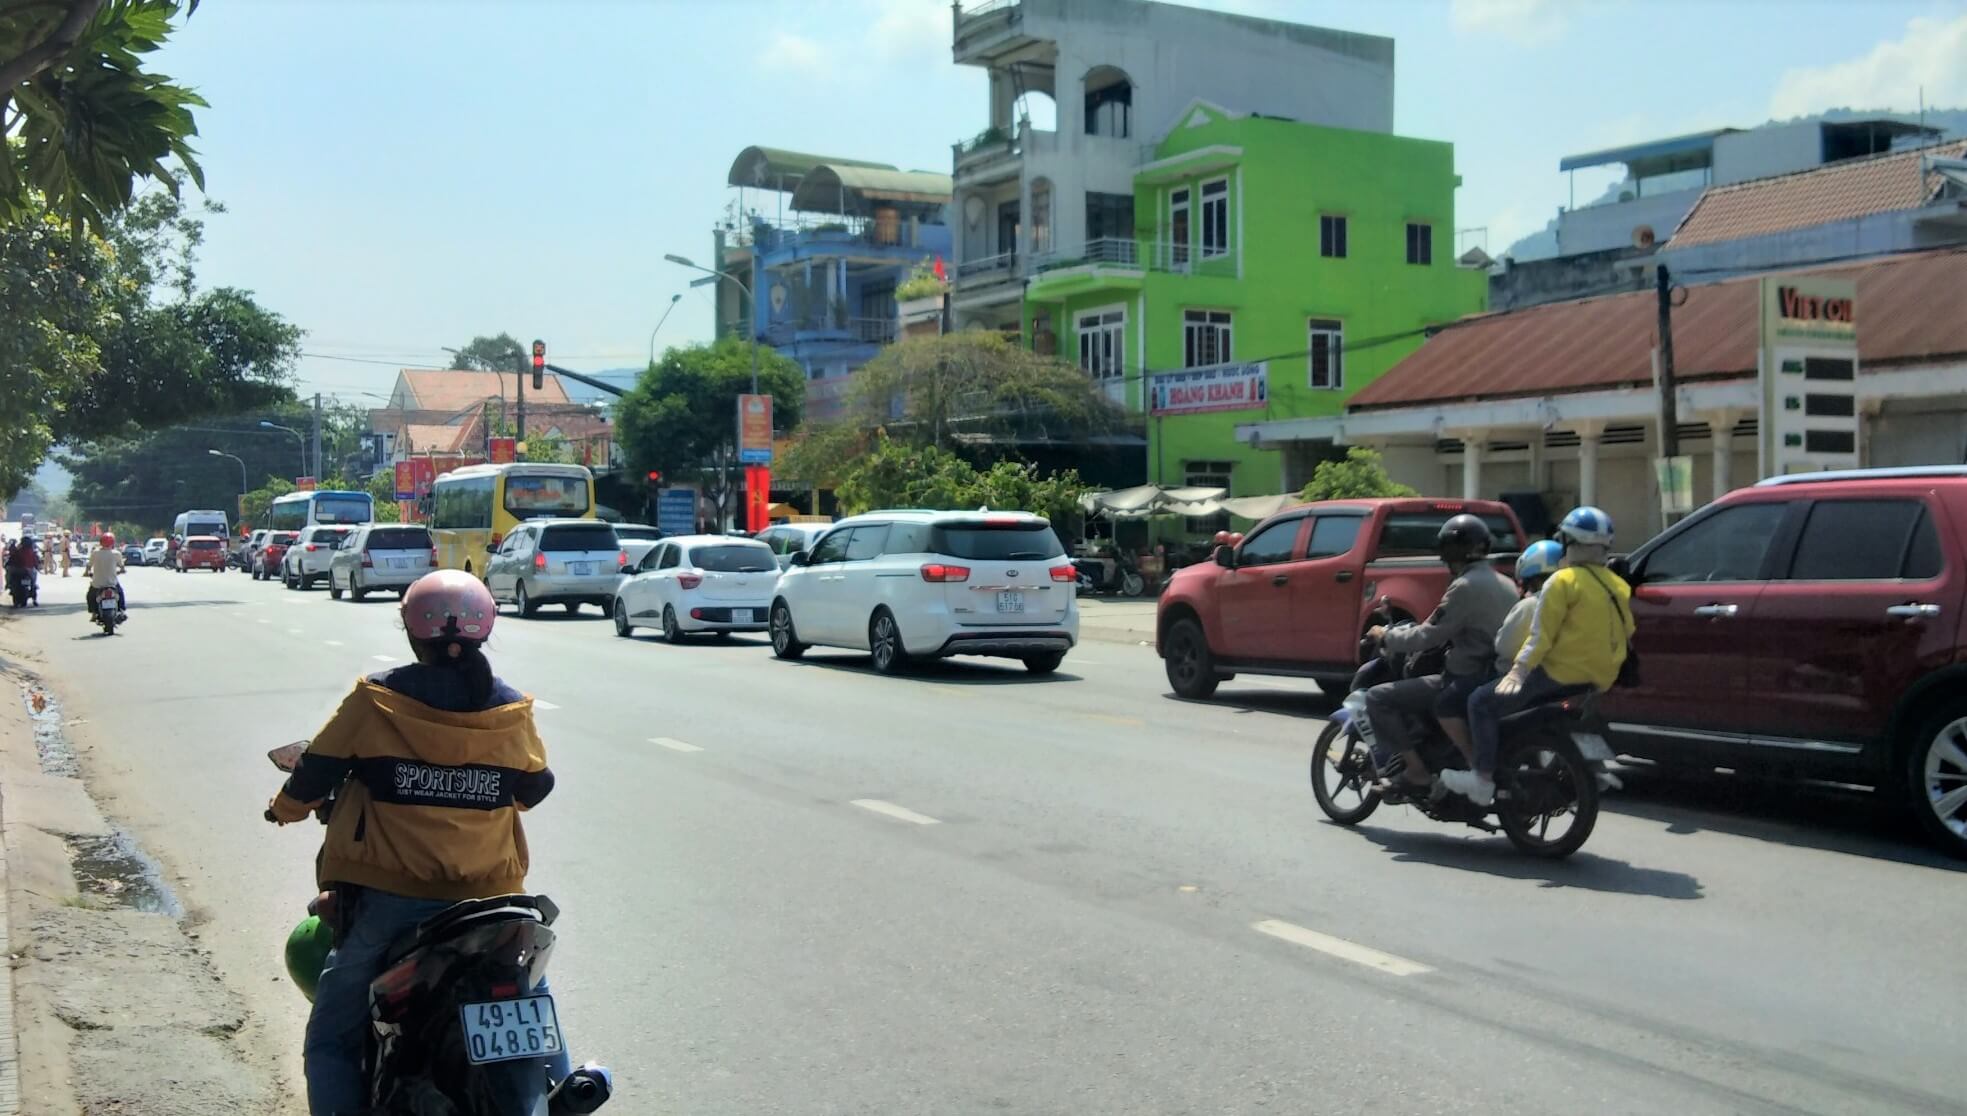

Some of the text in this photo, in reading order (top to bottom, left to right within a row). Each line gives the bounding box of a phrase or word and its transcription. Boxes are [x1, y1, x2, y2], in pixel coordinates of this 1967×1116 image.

[394, 762, 501, 796] SPORTSURE
[413, 789, 434, 797] WEAR
[435, 791, 461, 799] JACKET
[462, 793, 475, 801] FOR
[476, 795, 496, 803] STYLE
[479, 1000, 541, 1029] 49-L1
[472, 1026, 556, 1058] 048.65
